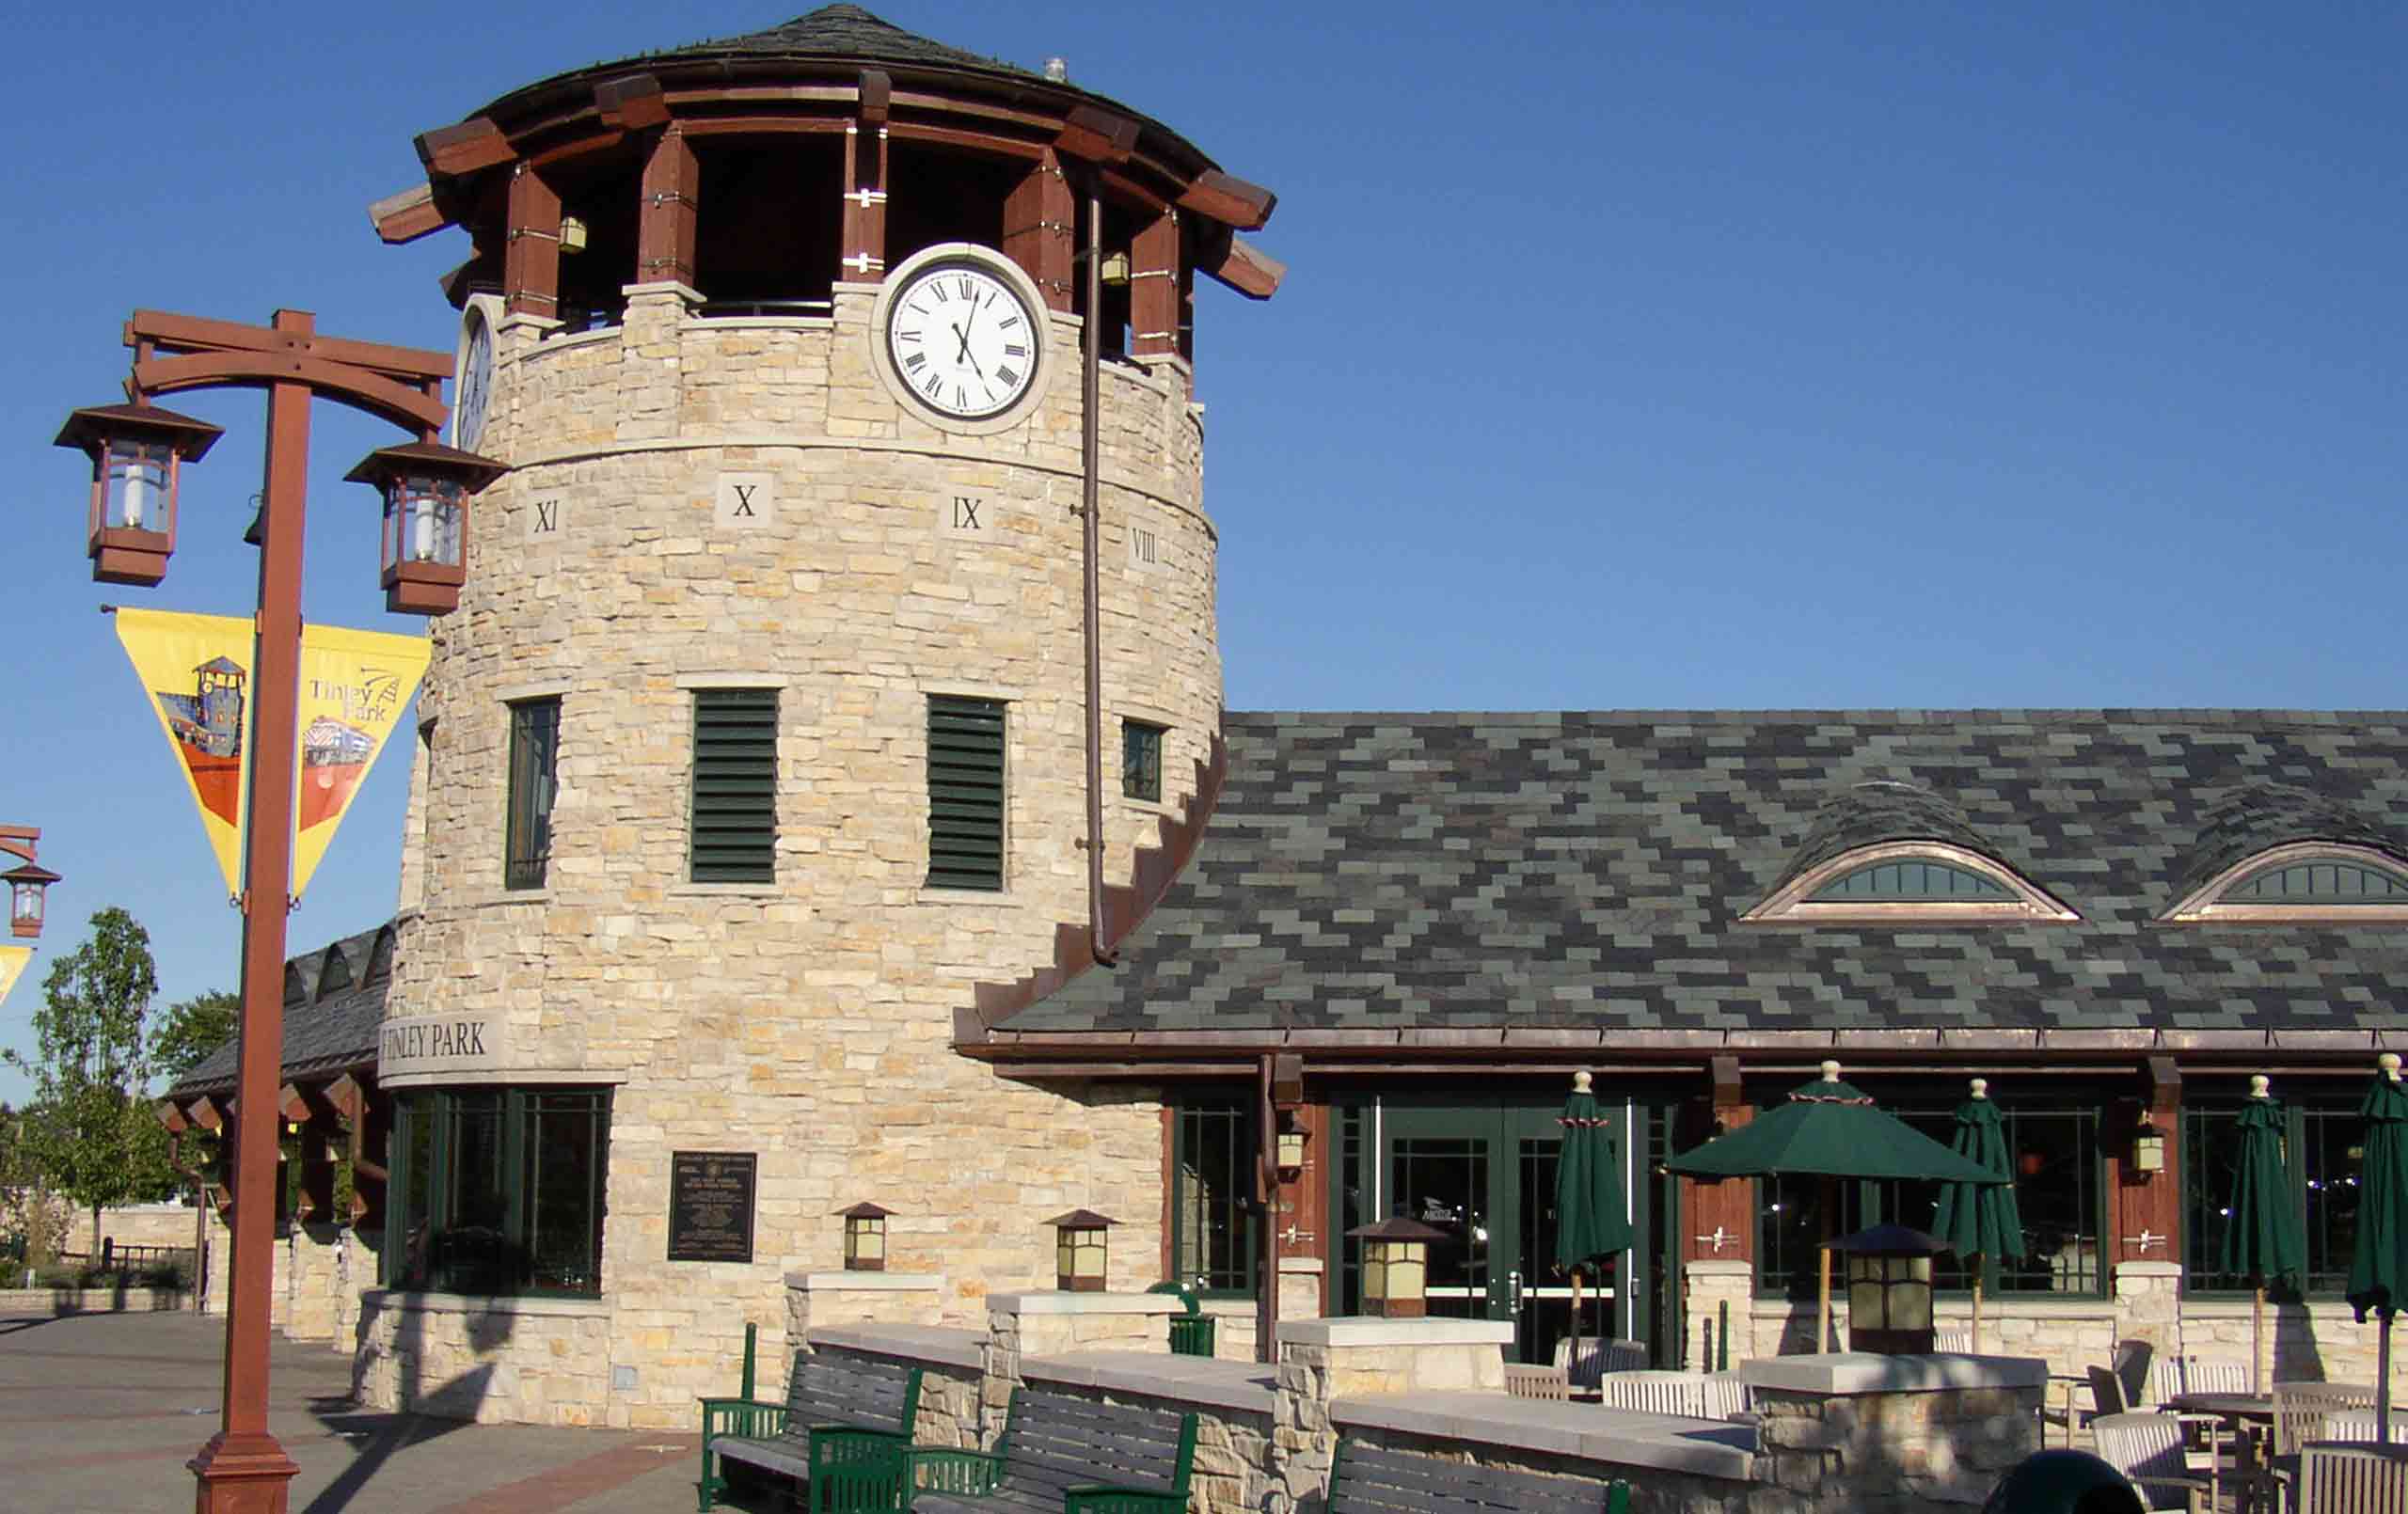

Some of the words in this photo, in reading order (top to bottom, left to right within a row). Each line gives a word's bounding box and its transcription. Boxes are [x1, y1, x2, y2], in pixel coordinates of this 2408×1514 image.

[534, 499, 558, 534] XI
[733, 484, 757, 516] X
[953, 497, 982, 529] IX
[1132, 527, 1155, 564] VIII
[433, 1022, 485, 1056] PARK
